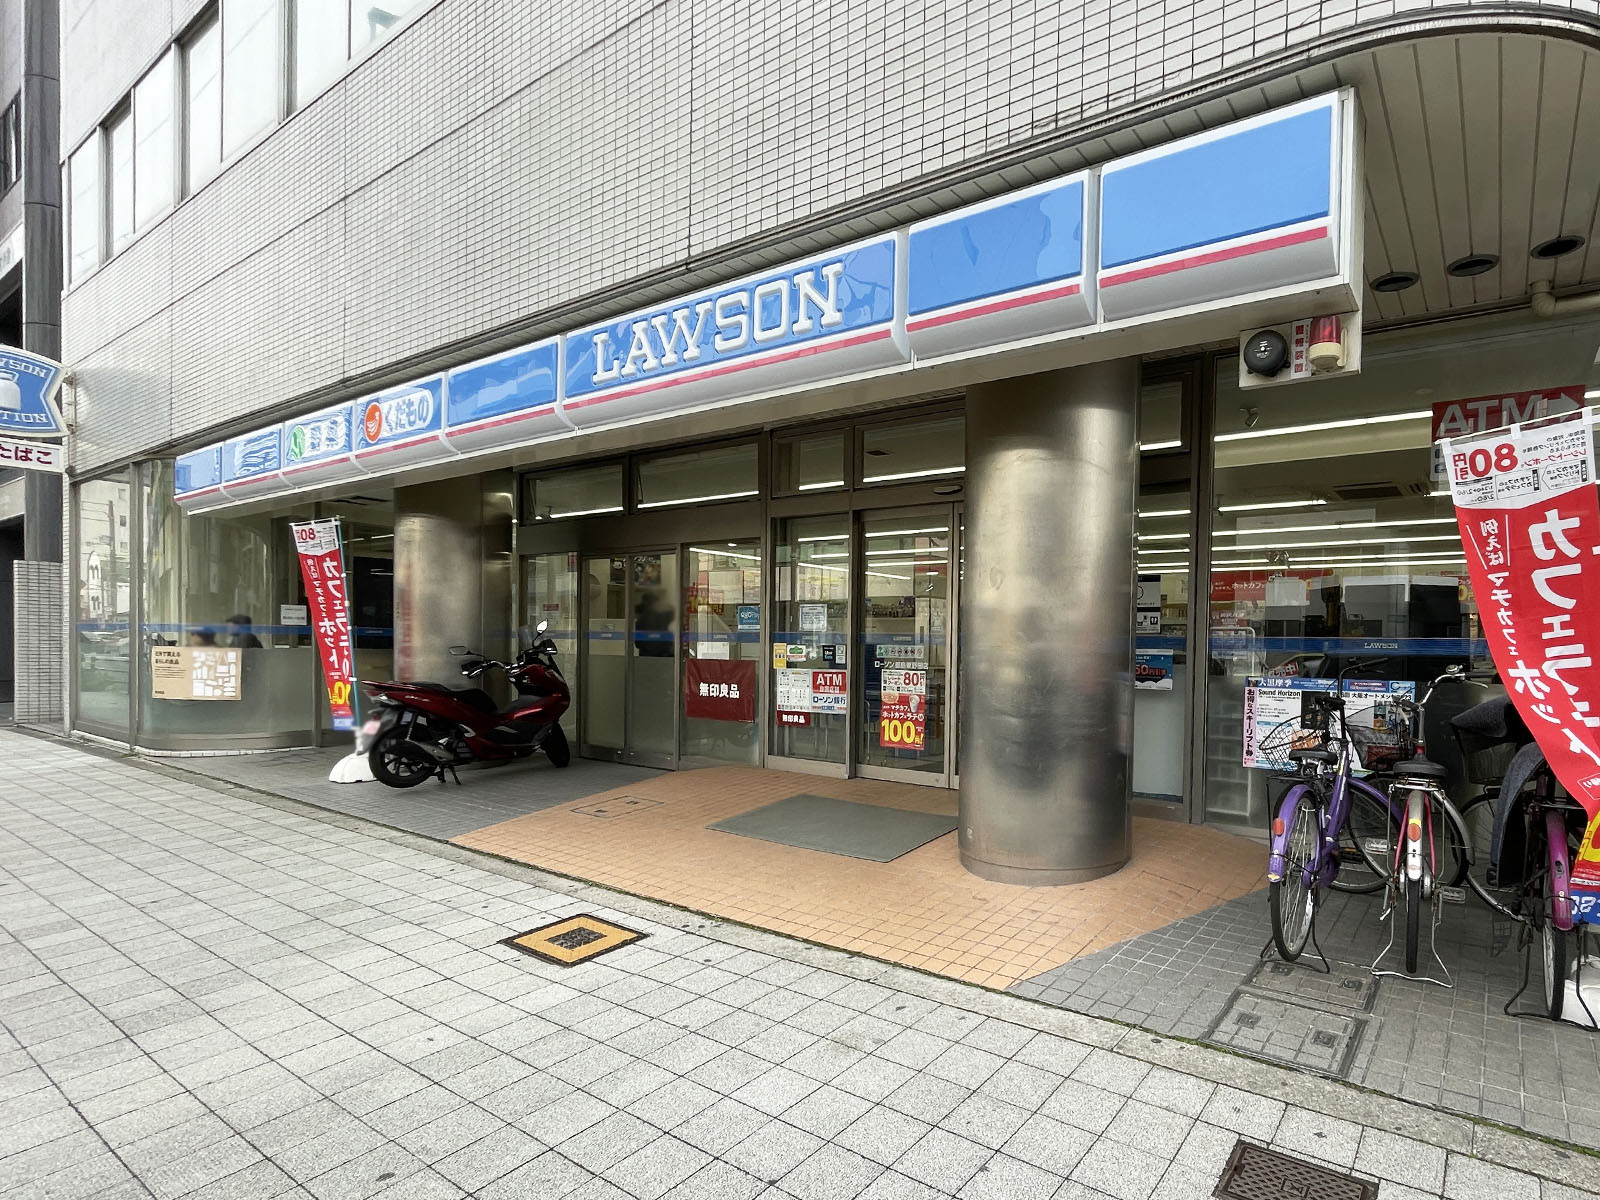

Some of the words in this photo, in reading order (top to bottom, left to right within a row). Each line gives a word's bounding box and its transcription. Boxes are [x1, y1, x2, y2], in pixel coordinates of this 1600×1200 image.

[592, 262, 844, 385] LAWSON
[383, 391, 432, 433] くだもの
[1436, 394, 1543, 437] ATM
[699, 682, 740, 699] 無印良品
[816, 673, 842, 686] ATM
[1277, 689, 1301, 697] Horizon
[812, 695, 846, 705] ローソン銀行
[1246, 688, 1256, 757] お得なスキーリフト券
